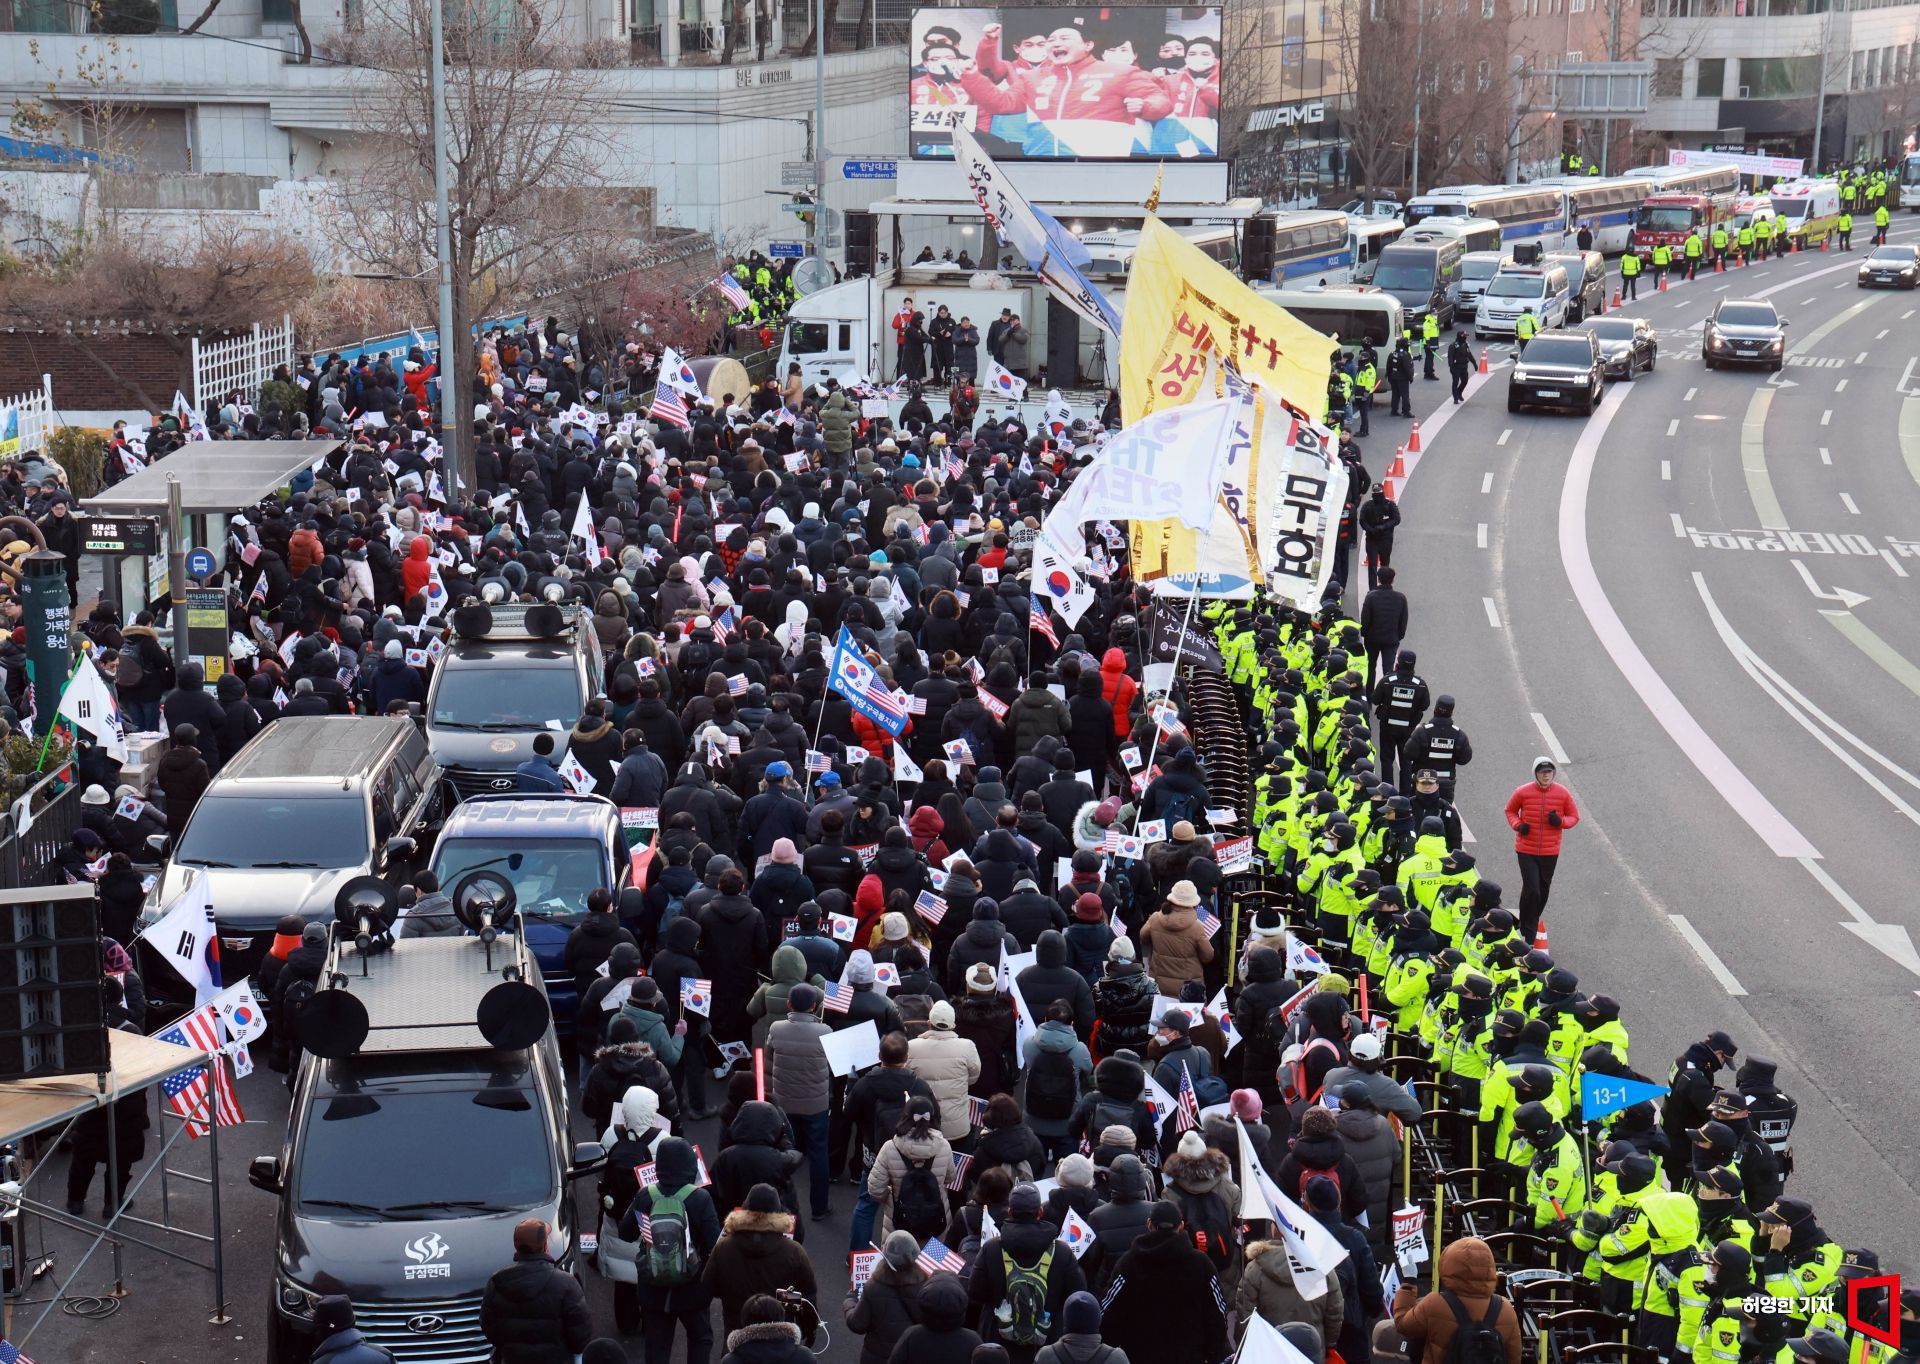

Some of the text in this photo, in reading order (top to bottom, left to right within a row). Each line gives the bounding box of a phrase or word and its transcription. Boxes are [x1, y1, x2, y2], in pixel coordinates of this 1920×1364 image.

[1272, 103, 1325, 128] AMG
[46, 634, 67, 649] 용산
[1593, 1087, 1627, 1105] 13-1
[1394, 1213, 1424, 1239] 반대
[404, 1267, 450, 1280] 남성연대
